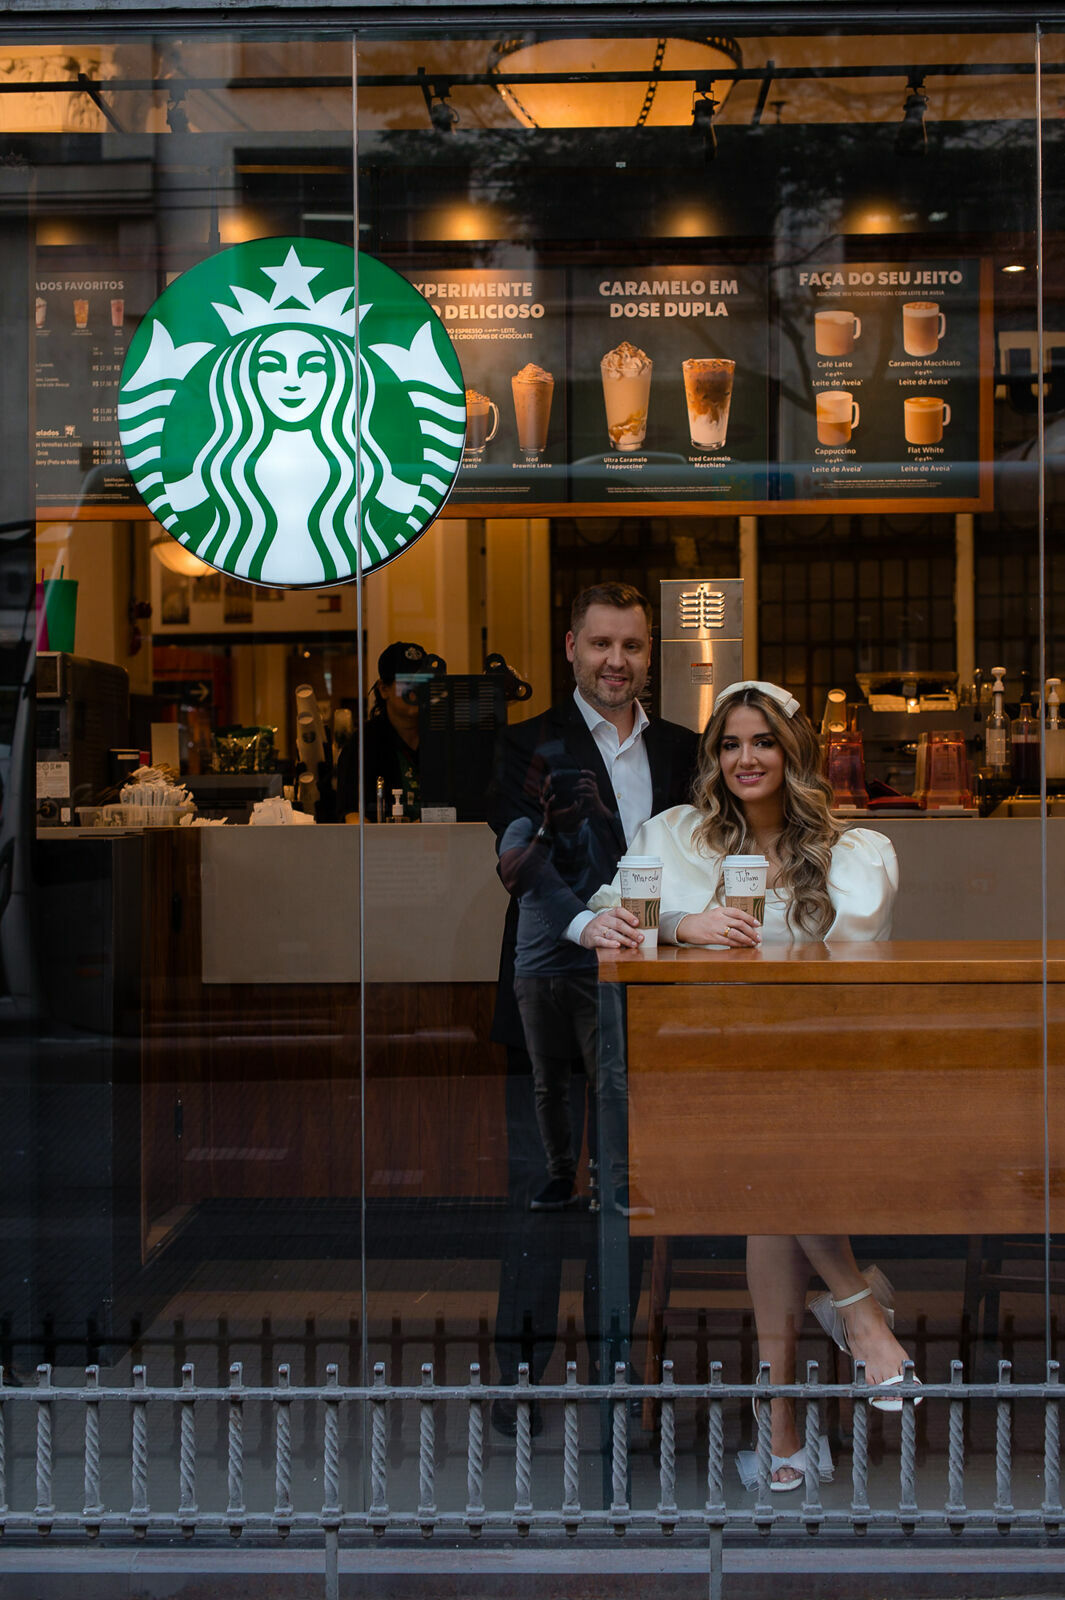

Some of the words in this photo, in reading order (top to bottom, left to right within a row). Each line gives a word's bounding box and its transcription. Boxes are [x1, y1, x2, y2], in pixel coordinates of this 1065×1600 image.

[799, 271, 845, 289] FAÇA
[848, 271, 875, 286] DO
[878, 270, 910, 285] SEU
[913, 270, 963, 285] JEITO
[64, 280, 125, 291] FAVORITOS
[598, 280, 706, 296] CARAMELO
[709, 280, 739, 295] EM
[444, 303, 545, 320] DELICIOSO
[610, 302, 661, 318] DOSE
[664, 301, 729, 318] DUPLA
[498, 332, 534, 340] CHOCOLATE
[816, 360, 834, 368] Café
[834, 360, 853, 368] Latte
[888, 359, 923, 367] Caramelo
[923, 359, 961, 367] Macchiato
[812, 379, 830, 387] Leite
[830, 379, 840, 387] de
[898, 378, 917, 386] Leite
[917, 378, 927, 386] de
[814, 447, 857, 456] Cappuccino
[907, 447, 921, 455] Flat
[921, 447, 944, 455] White
[811, 465, 830, 473] Leite
[830, 465, 840, 473] de
[900, 464, 919, 473] Leite
[919, 464, 929, 472] de
